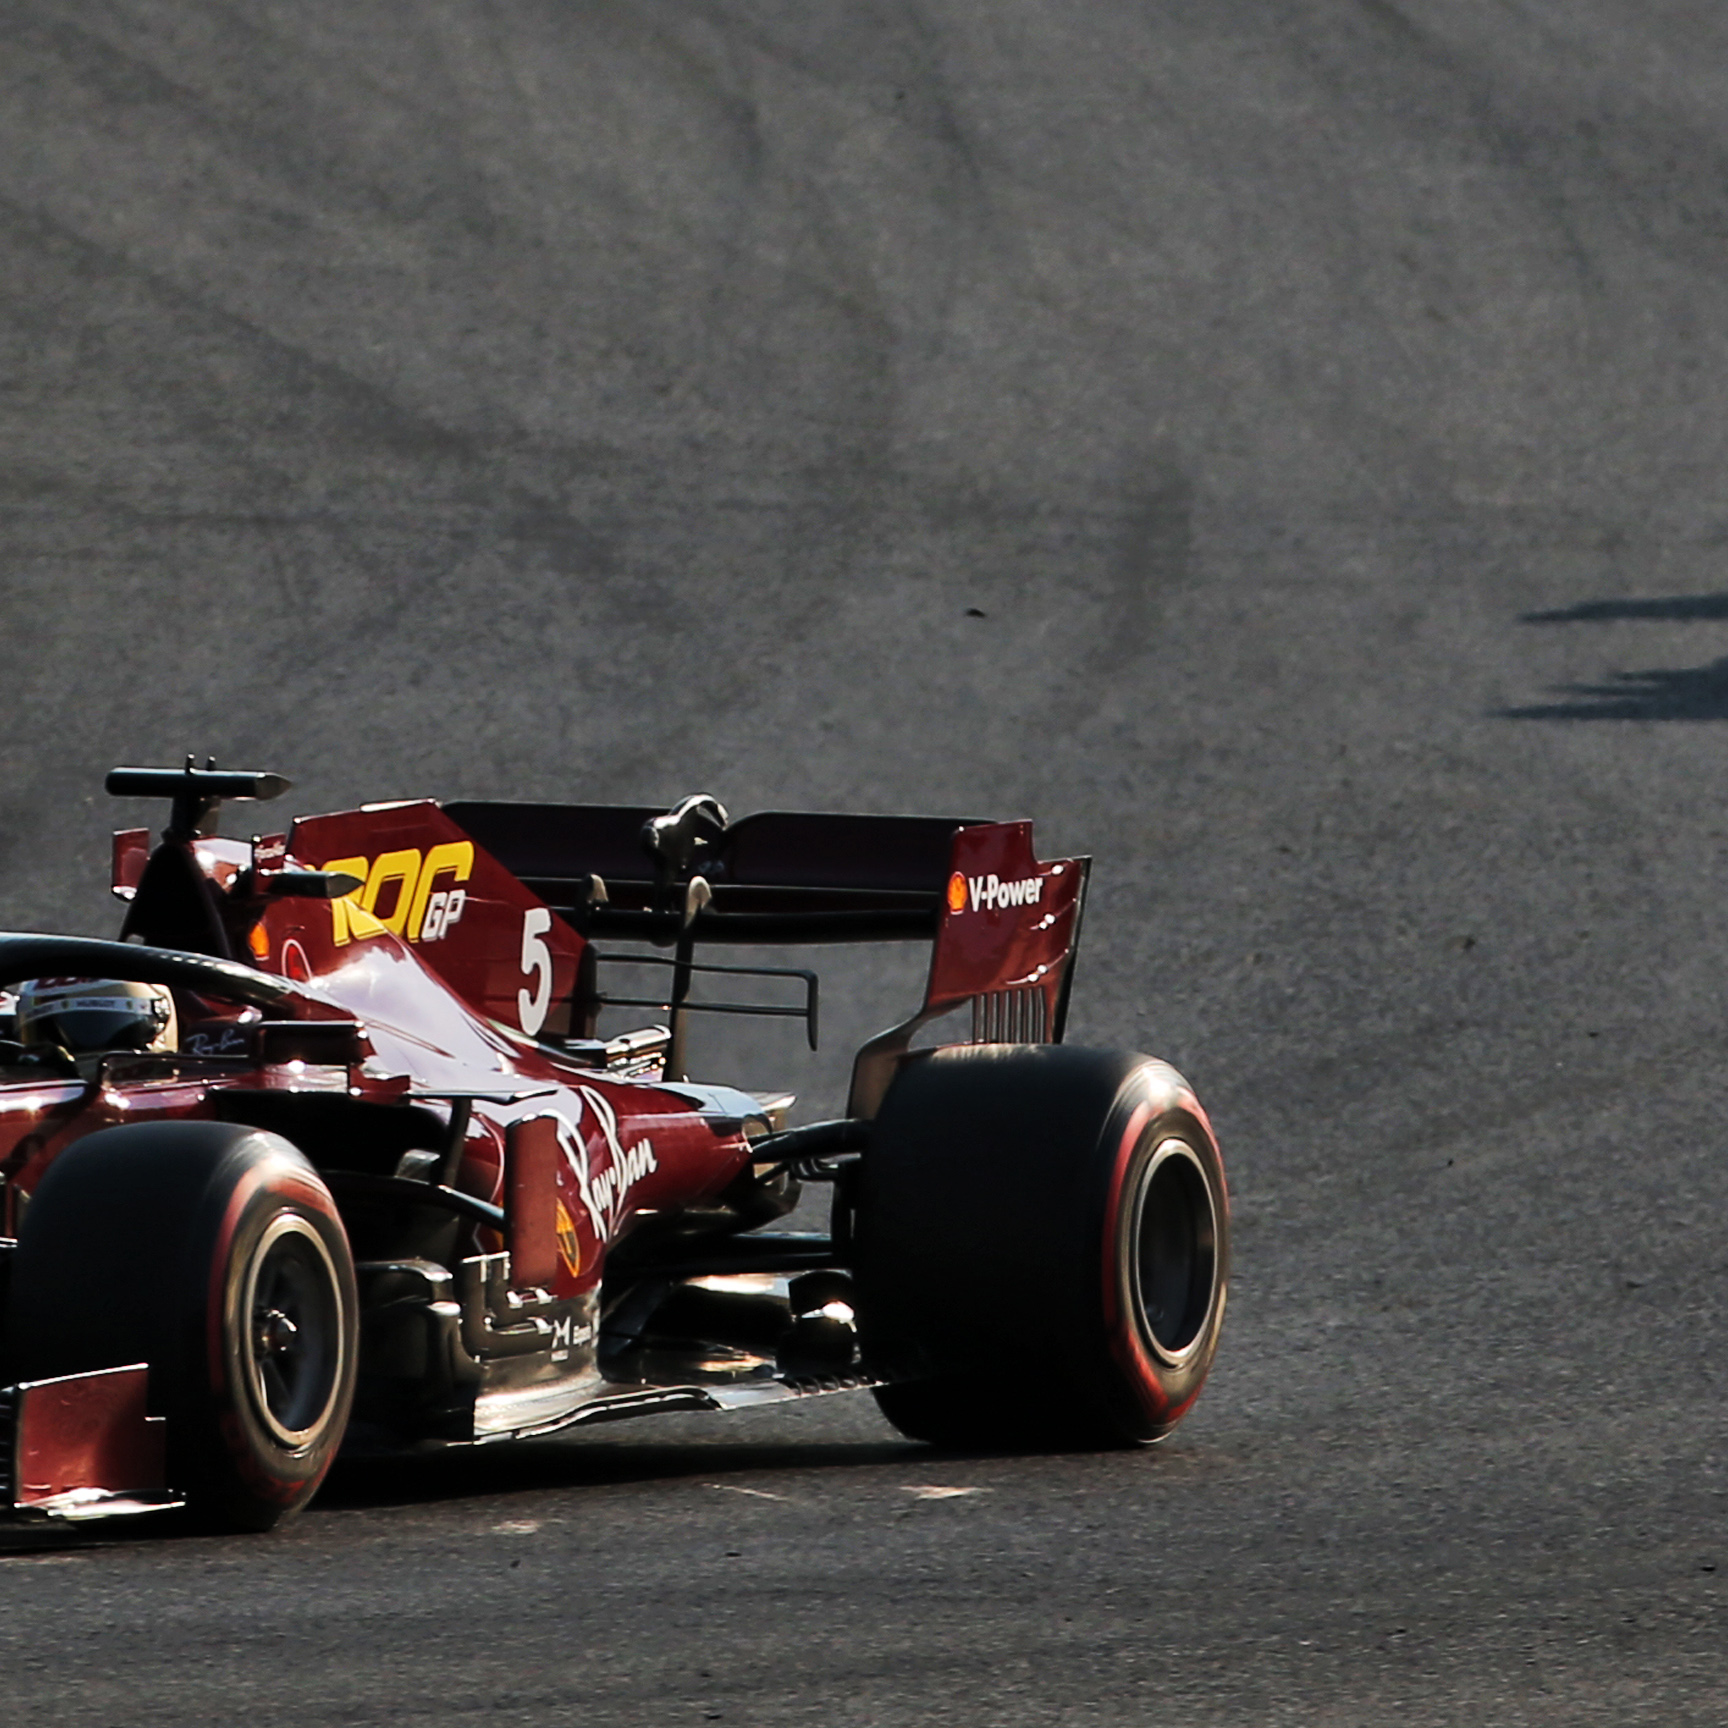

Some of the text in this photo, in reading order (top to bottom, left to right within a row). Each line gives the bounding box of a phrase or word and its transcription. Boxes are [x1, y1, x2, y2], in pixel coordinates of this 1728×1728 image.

[421, 889, 466, 942] GP
[968, 874, 1043, 912] V-Power
[518, 907, 554, 1037] 5
